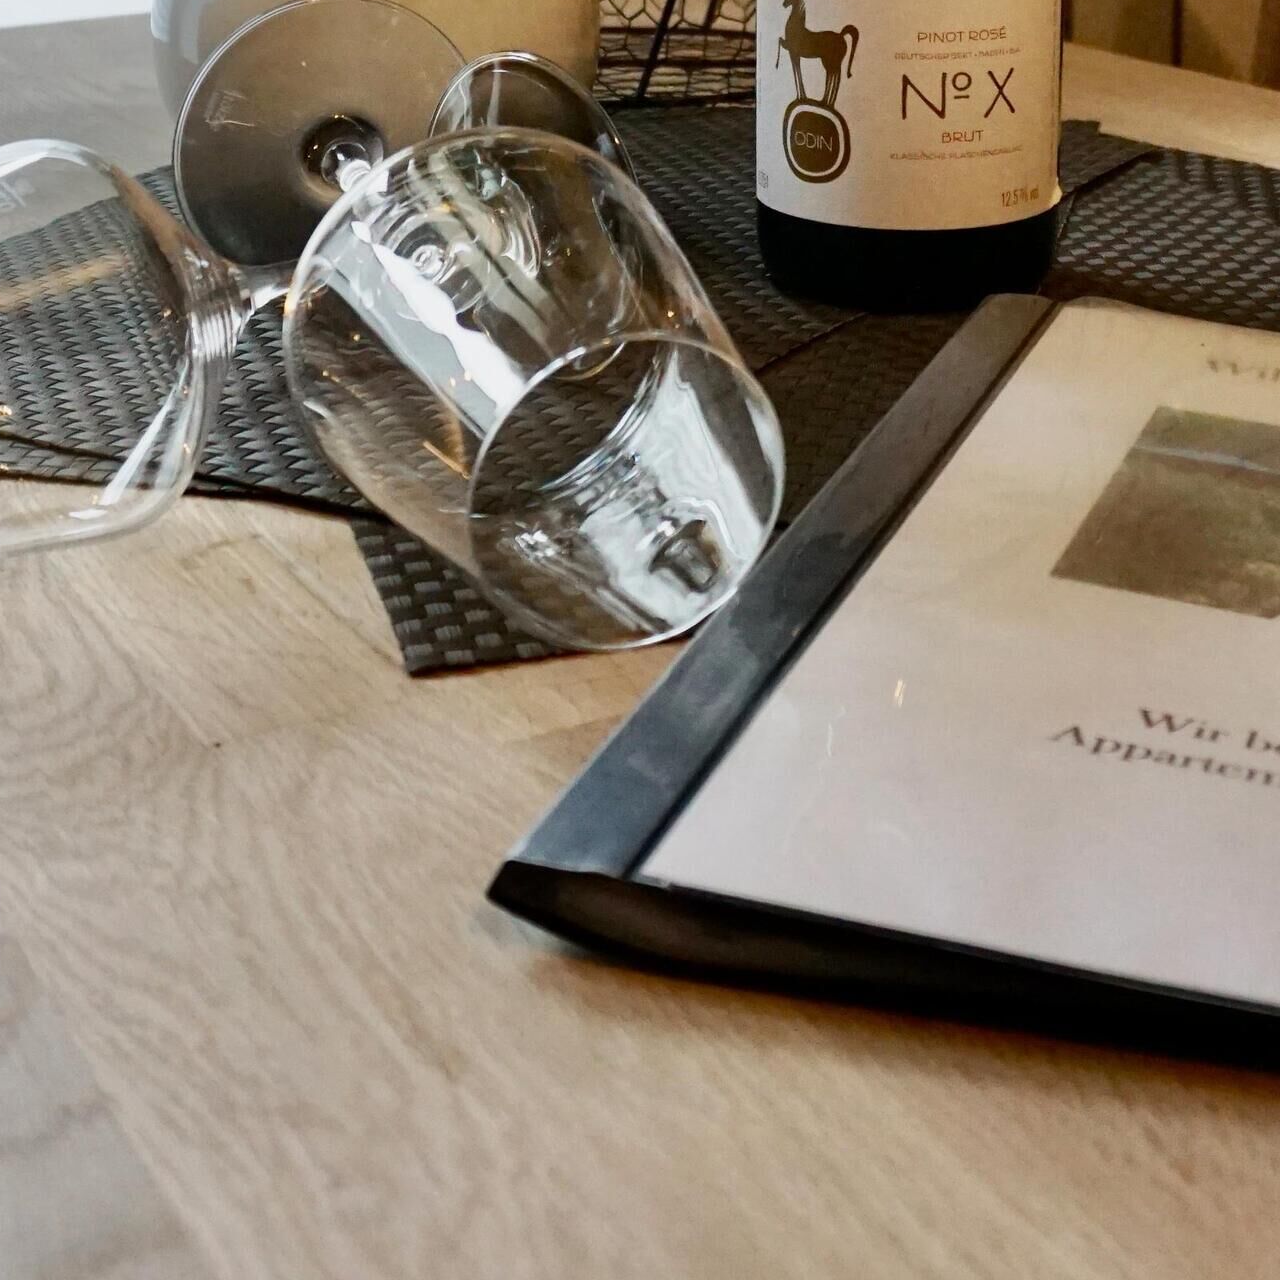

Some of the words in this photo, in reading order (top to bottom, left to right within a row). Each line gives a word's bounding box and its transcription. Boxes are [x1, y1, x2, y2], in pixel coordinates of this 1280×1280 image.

[917, 30, 966, 43] PINOT
[968, 25, 1008, 41] ROSÉ
[983, 66, 1016, 119] X
[794, 131, 833, 152] ODIN
[941, 129, 984, 144] BRUT
[1138, 707, 1229, 742] Wir
